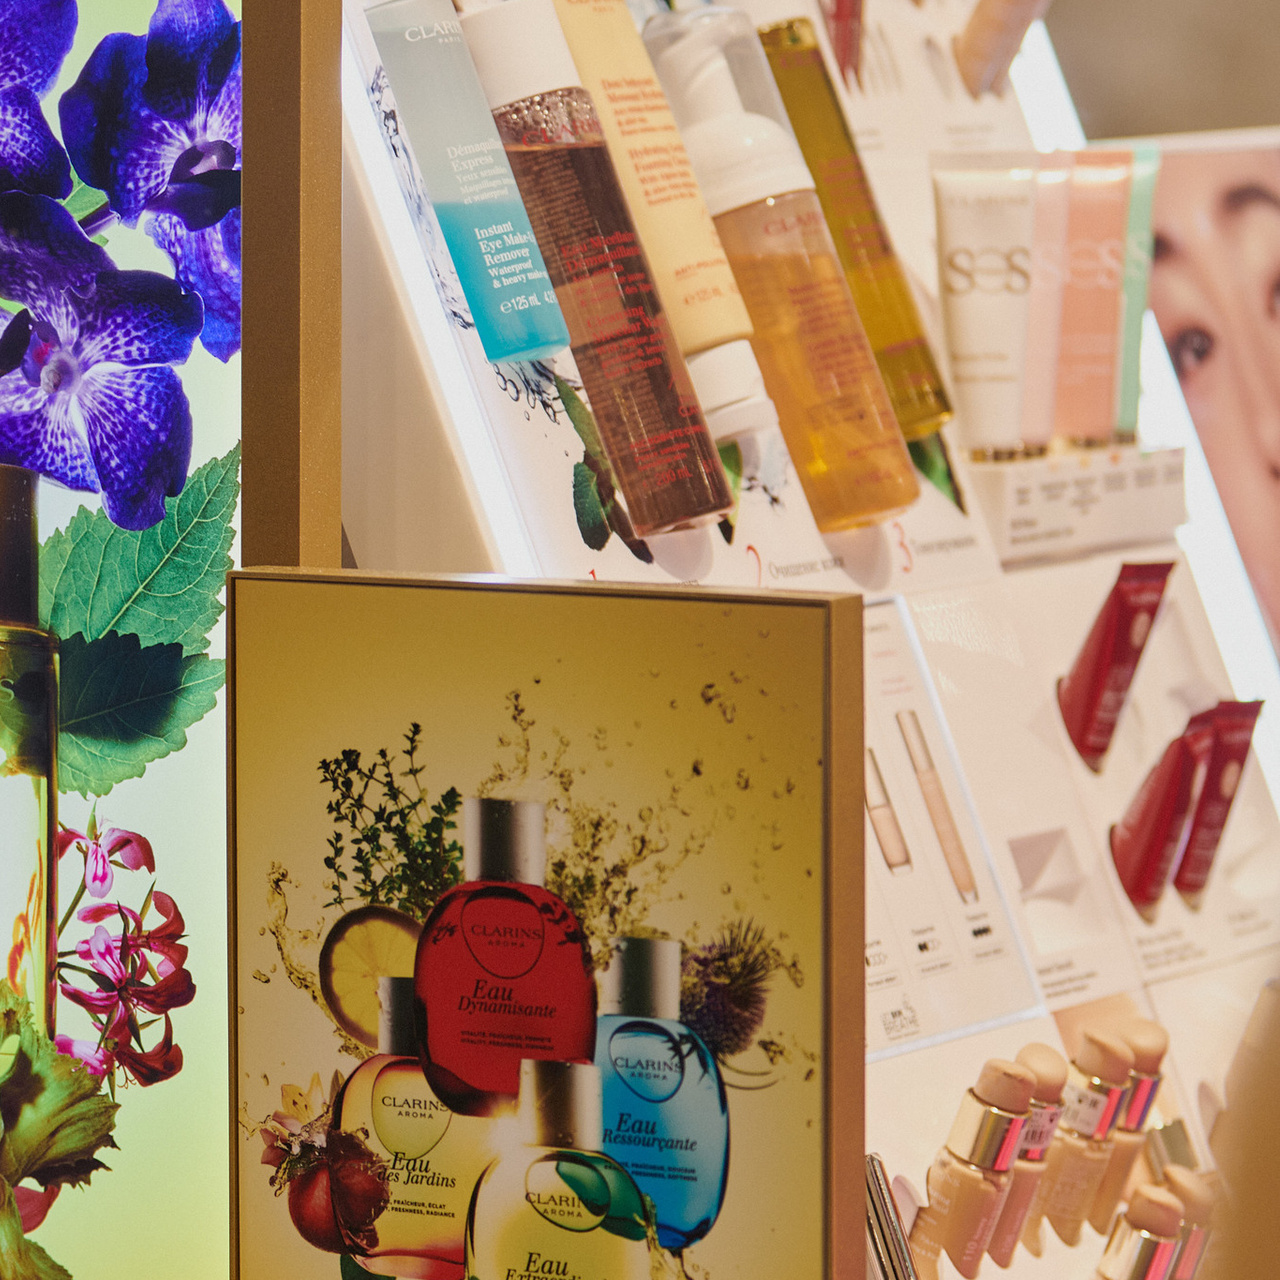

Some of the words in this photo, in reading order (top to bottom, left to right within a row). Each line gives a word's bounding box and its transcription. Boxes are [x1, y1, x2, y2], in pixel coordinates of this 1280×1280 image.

[474, 221, 514, 240] Instant
[479, 238, 502, 253] Eye
[483, 247, 530, 267] Remover
[470, 923, 542, 939] CLARINS
[471, 978, 514, 1002] Eau
[457, 995, 557, 1019] Dynamisante
[614, 1056, 682, 1074] CLARINS
[381, 1095, 449, 1112] CLARINS
[397, 1110, 434, 1120] AROMA
[616, 1112, 657, 1136] Eau
[602, 1128, 698, 1153] Ressourçante
[391, 1151, 431, 1173] Eau
[377, 1167, 400, 1183] des
[403, 1170, 457, 1189] Jardins
[542, 1207, 583, 1219] AROMA
[524, 1251, 569, 1277] Eau
